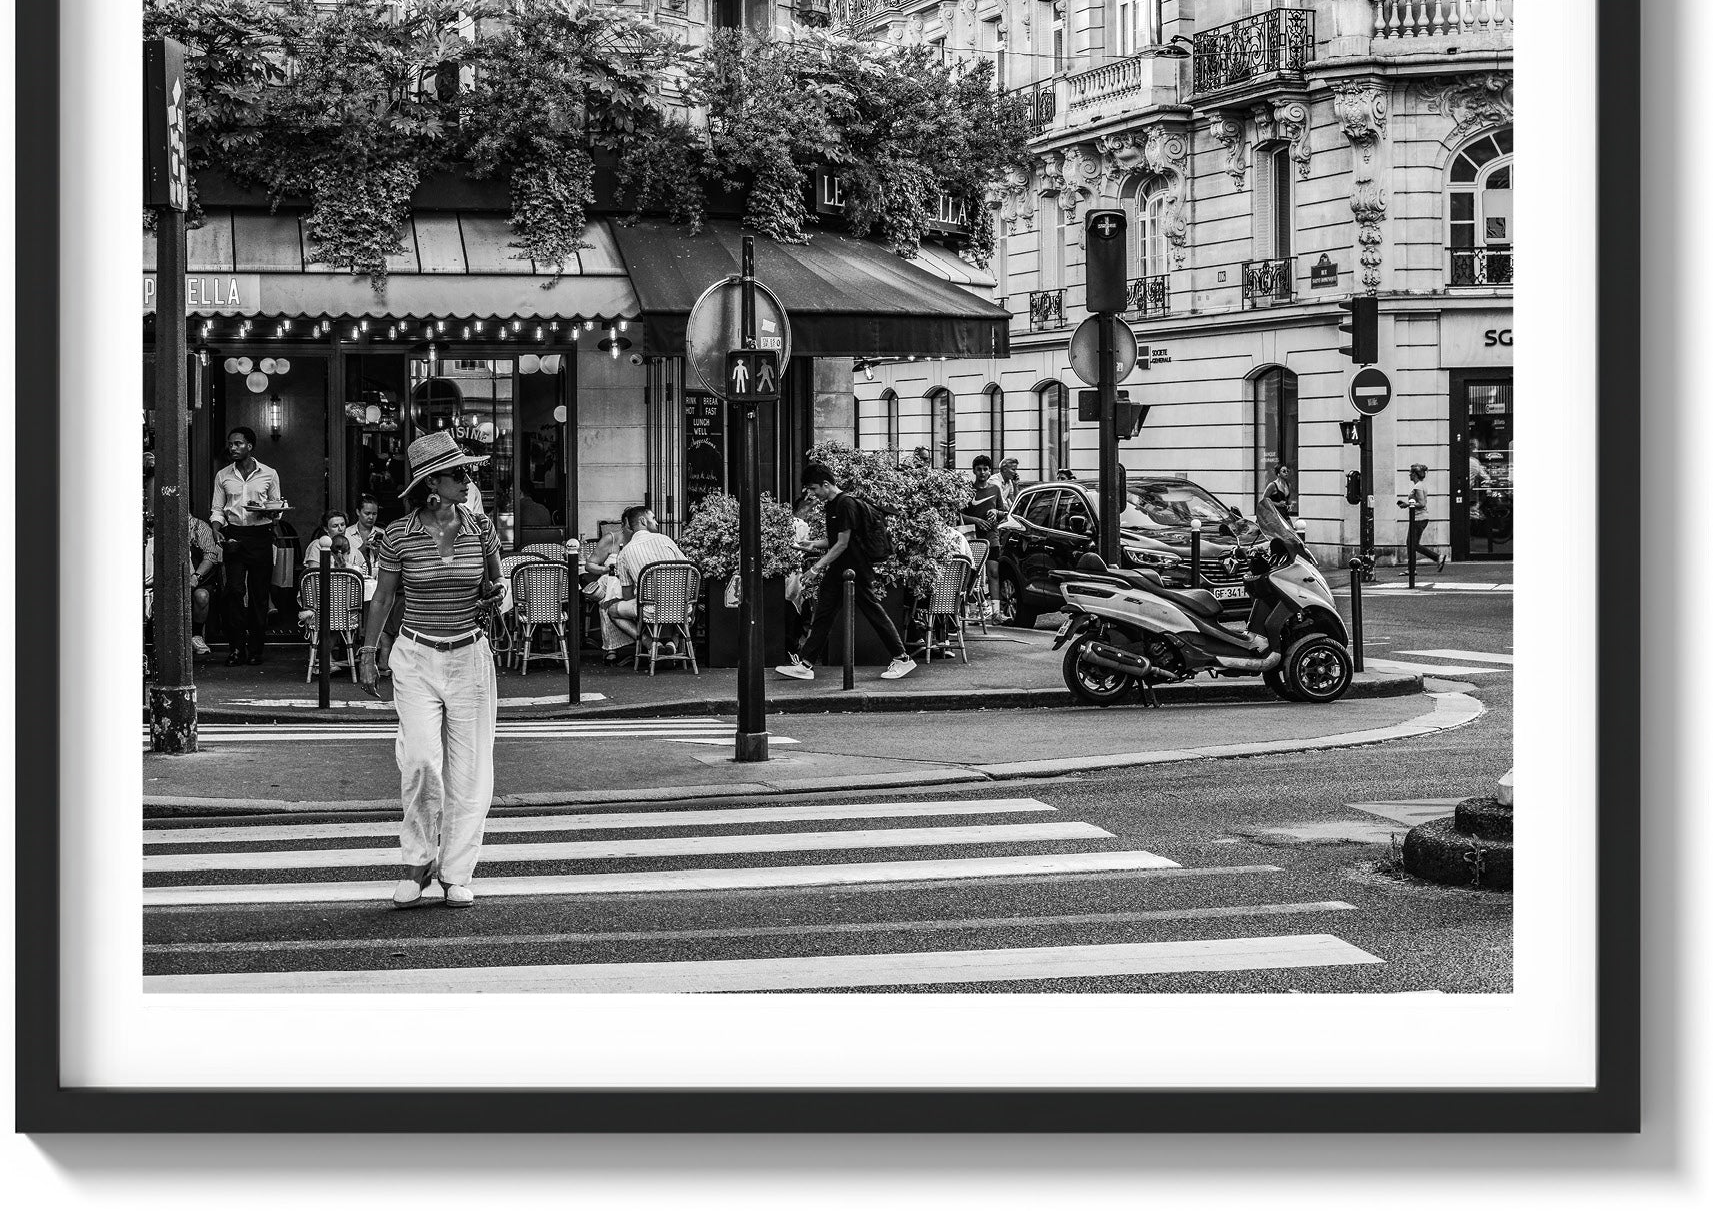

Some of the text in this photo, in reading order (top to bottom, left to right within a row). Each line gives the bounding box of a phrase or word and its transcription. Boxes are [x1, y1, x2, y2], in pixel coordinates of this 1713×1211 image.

[823, 175, 846, 207] LE
[144, 278, 241, 306] PELLA
[1485, 329, 1513, 347] SG
[686, 396, 697, 405] RINK
[703, 397, 718, 406] BREAK
[685, 406, 695, 415] HOT
[705, 407, 717, 416] FAST
[693, 418, 710, 427] LUNCH
[694, 428, 708, 436] WELL
[1215, 588, 1247, 599] GF-341-
